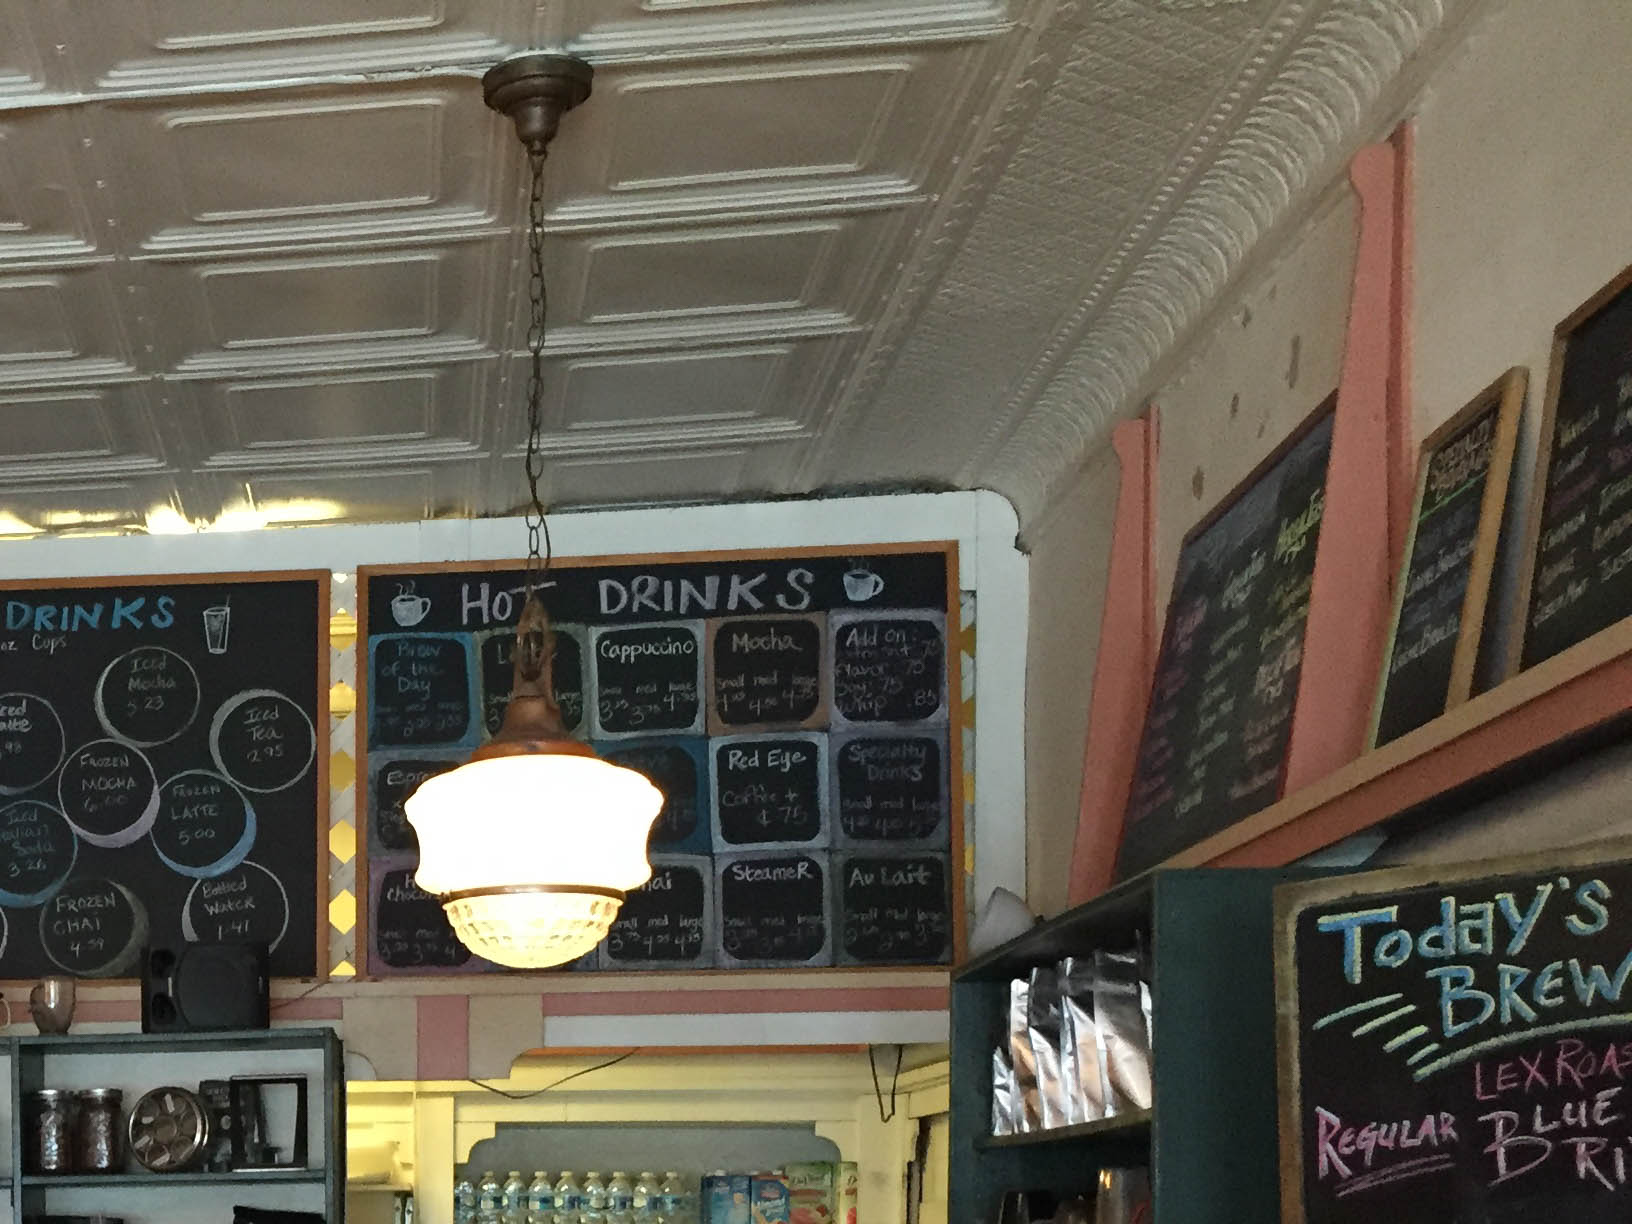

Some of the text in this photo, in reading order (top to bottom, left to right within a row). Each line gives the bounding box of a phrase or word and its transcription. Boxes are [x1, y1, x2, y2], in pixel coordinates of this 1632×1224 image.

[599, 568, 816, 615] DRINKS
[6, 595, 175, 632] DRINKS
[32, 633, 68, 655] Cups
[601, 636, 695, 664] Cappuccino
[732, 627, 803, 653] Mocha
[728, 749, 807, 772] Red Eye
